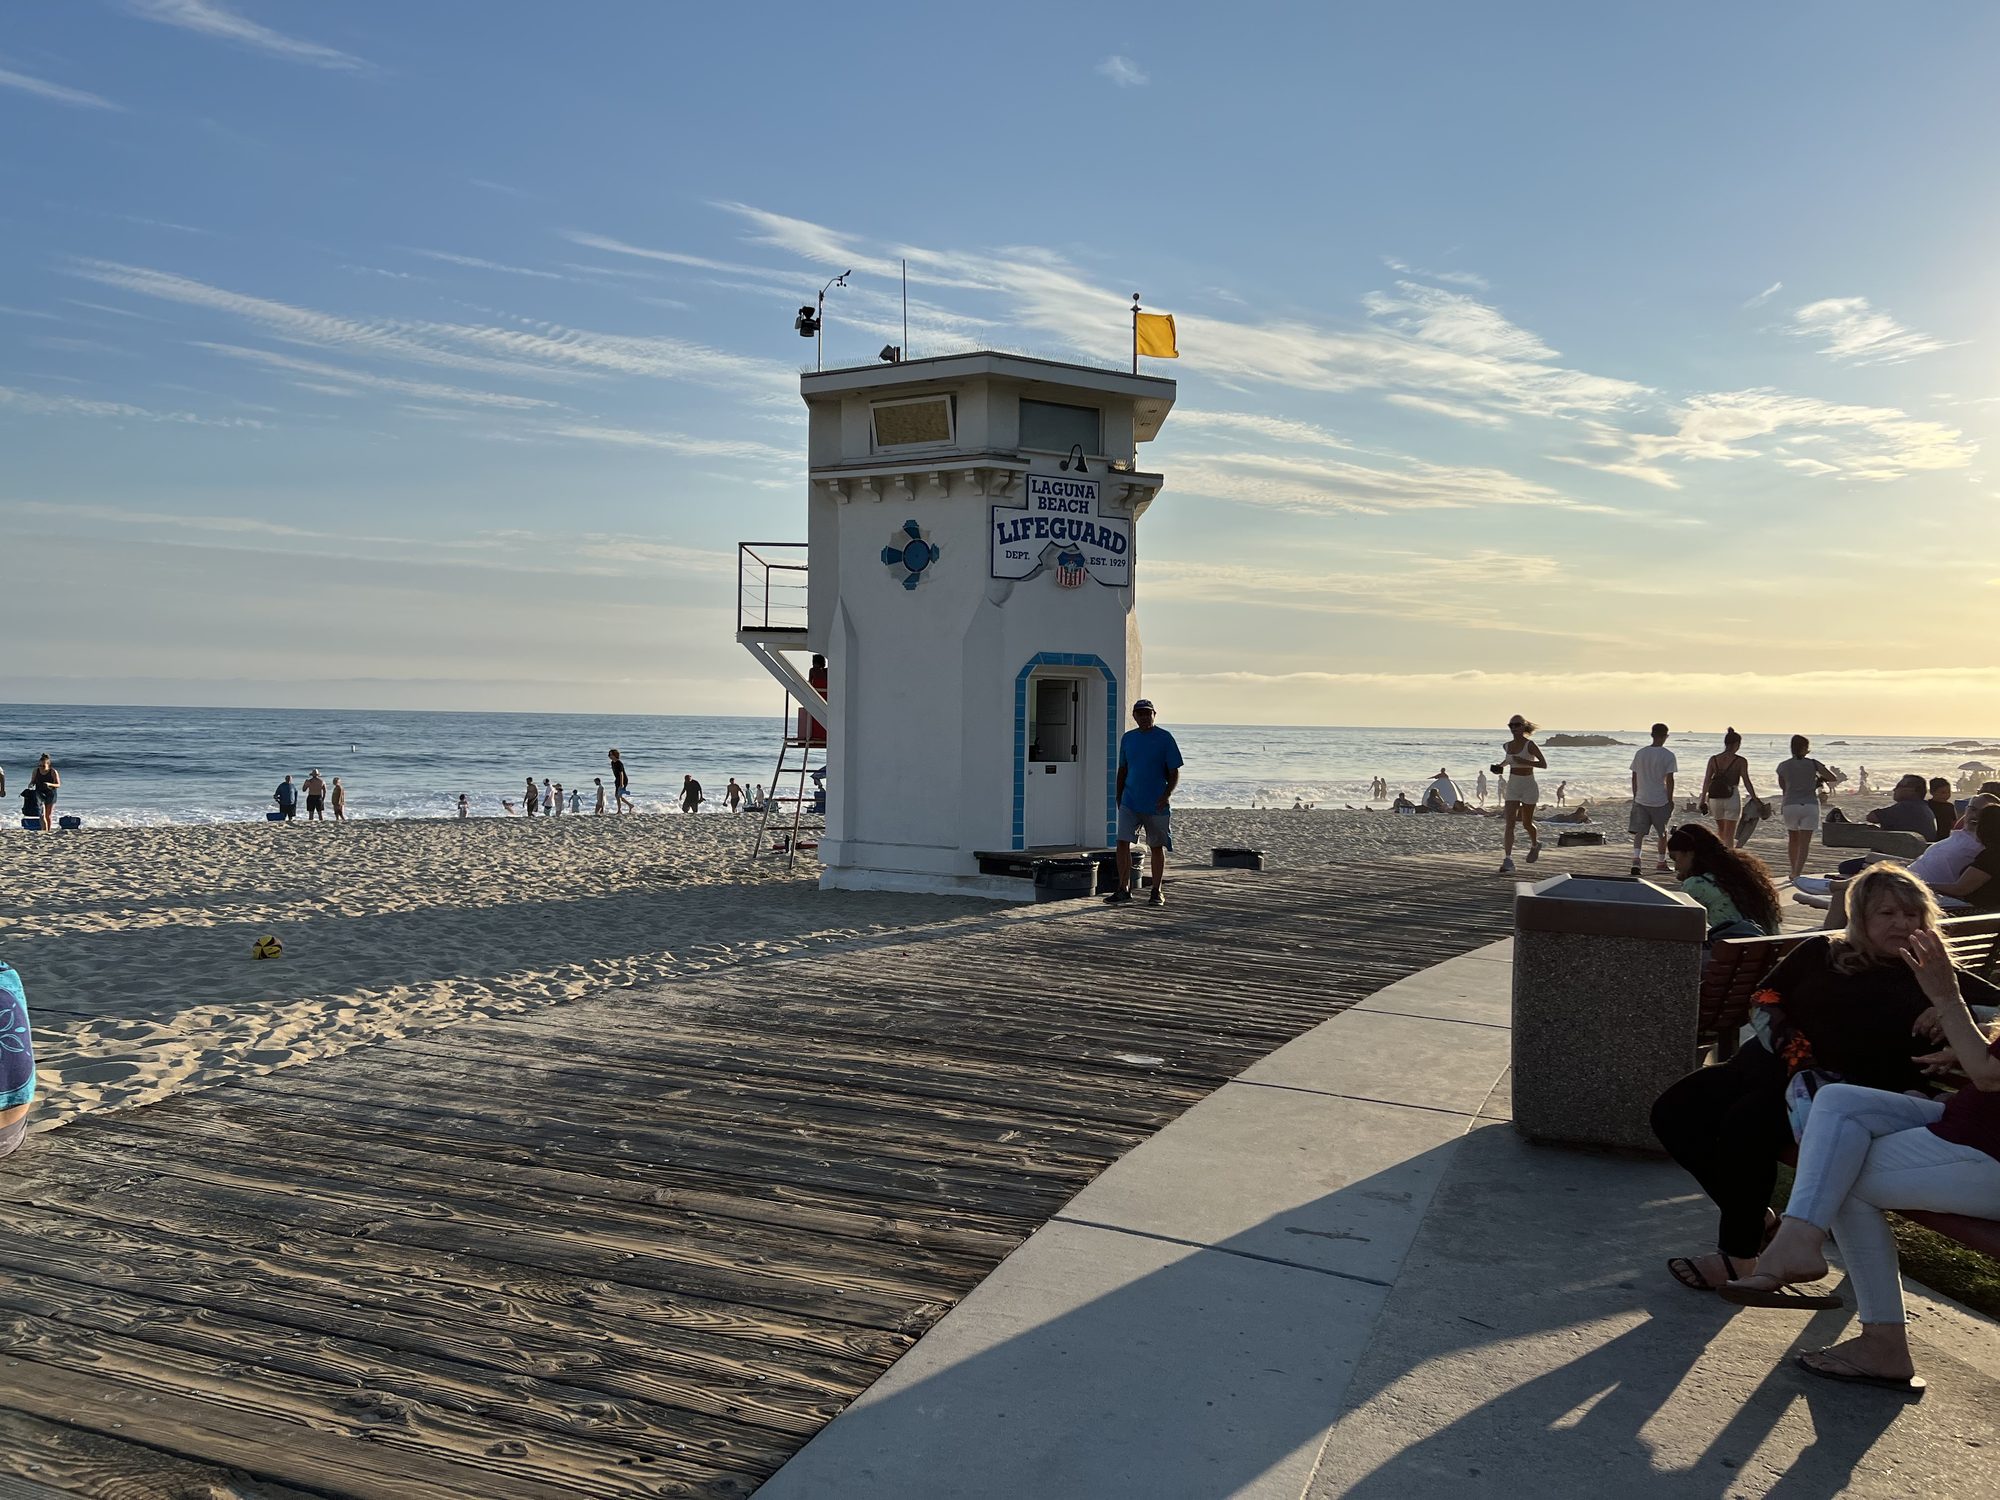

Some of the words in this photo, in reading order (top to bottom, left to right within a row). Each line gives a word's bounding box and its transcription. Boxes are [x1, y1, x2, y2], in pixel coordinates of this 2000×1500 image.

[1031, 479, 1096, 499] LAGUNA
[1037, 496, 1089, 514] BEACH
[996, 517, 1127, 555] LIFEGUARD
[1005, 550, 1030, 560] DEPT.
[1090, 557, 1107, 566] EST.
[1109, 558, 1126, 567] 1929
